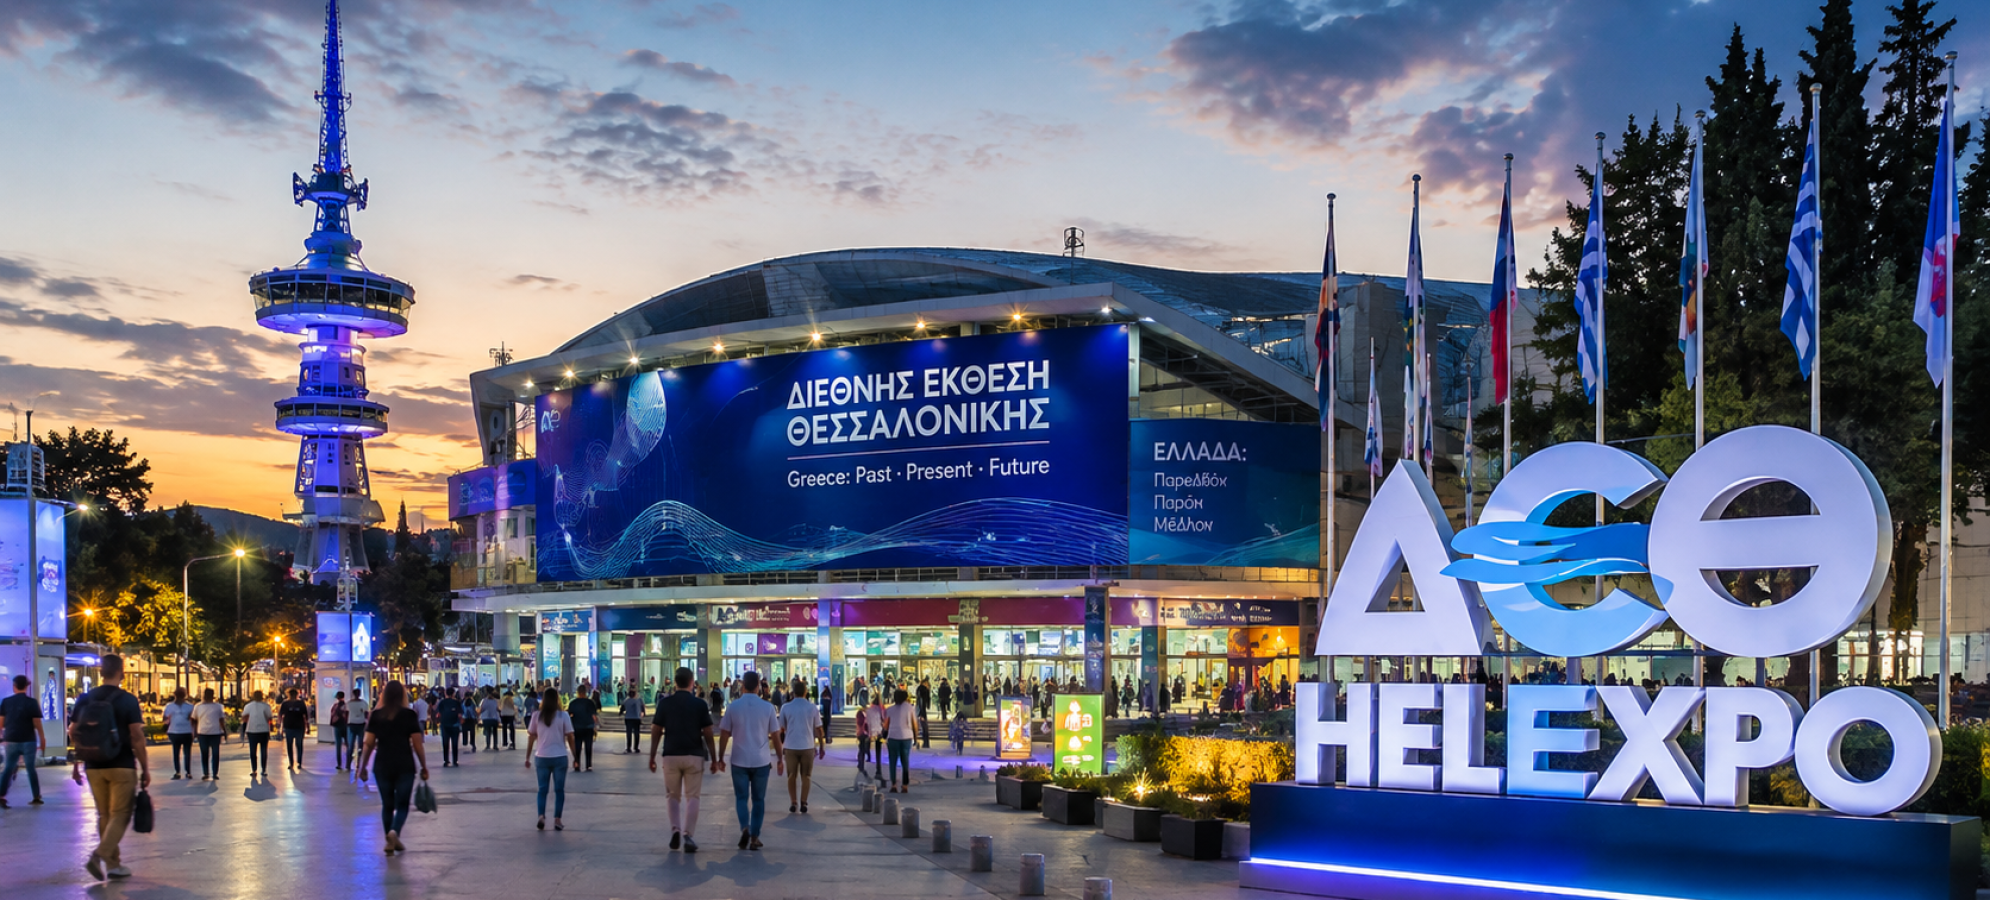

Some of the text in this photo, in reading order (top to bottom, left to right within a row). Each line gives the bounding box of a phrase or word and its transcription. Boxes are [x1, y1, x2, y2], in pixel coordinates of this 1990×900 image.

[787, 360, 1050, 410] ΔΙΕΘΝΗΣ ΕΚΘΕΣΗ
[787, 398, 1050, 447] ΘΕΣΣΑΛΟΝΙΚΗΣ
[788, 470, 850, 488] Greece:
[857, 466, 892, 484] Past
[907, 461, 973, 480] Present
[990, 457, 1050, 476] Future
[1154, 442, 1247, 461] ΕΛΛΑΔΑ:
[1295, 682, 1942, 814] HELEXPO
